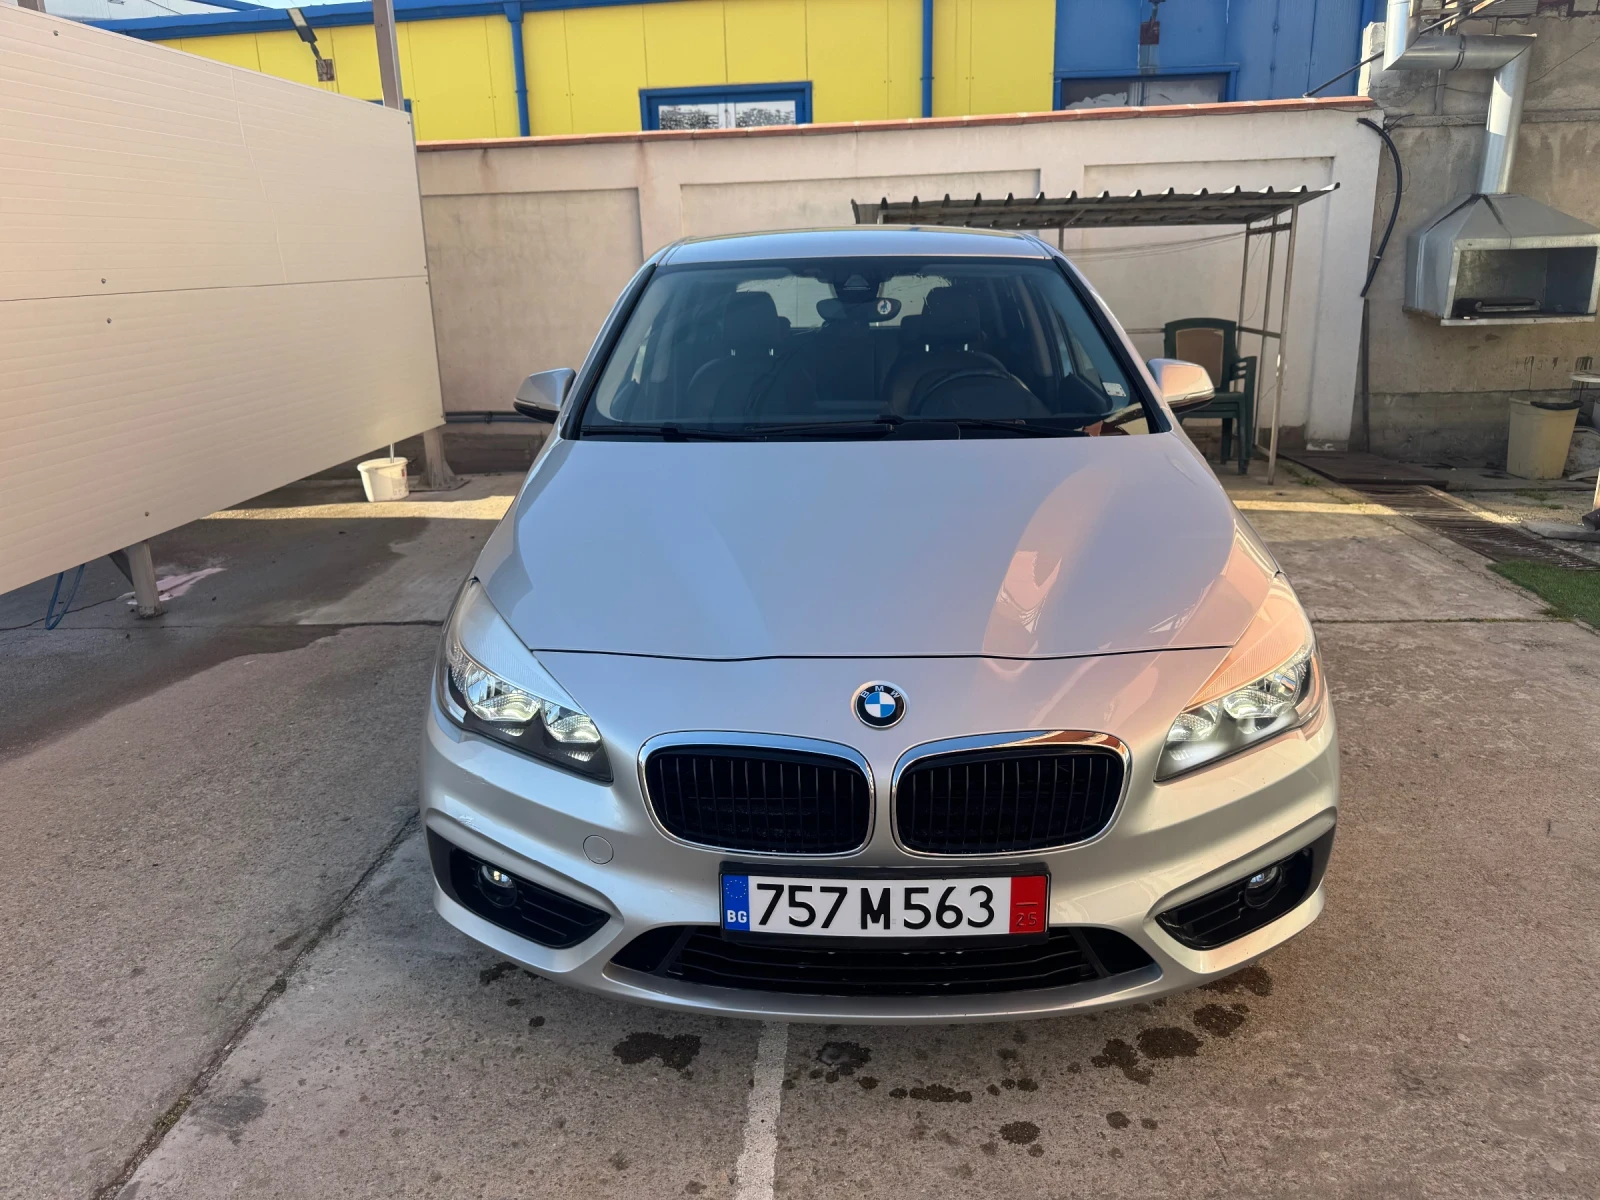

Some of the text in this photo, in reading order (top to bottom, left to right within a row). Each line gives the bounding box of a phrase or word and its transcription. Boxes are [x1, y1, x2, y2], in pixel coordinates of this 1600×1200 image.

[860, 685, 901, 698] BMW
[756, 883, 995, 930] 757 M 563
[727, 909, 748, 923] BG
[1016, 911, 1037, 927] 25
